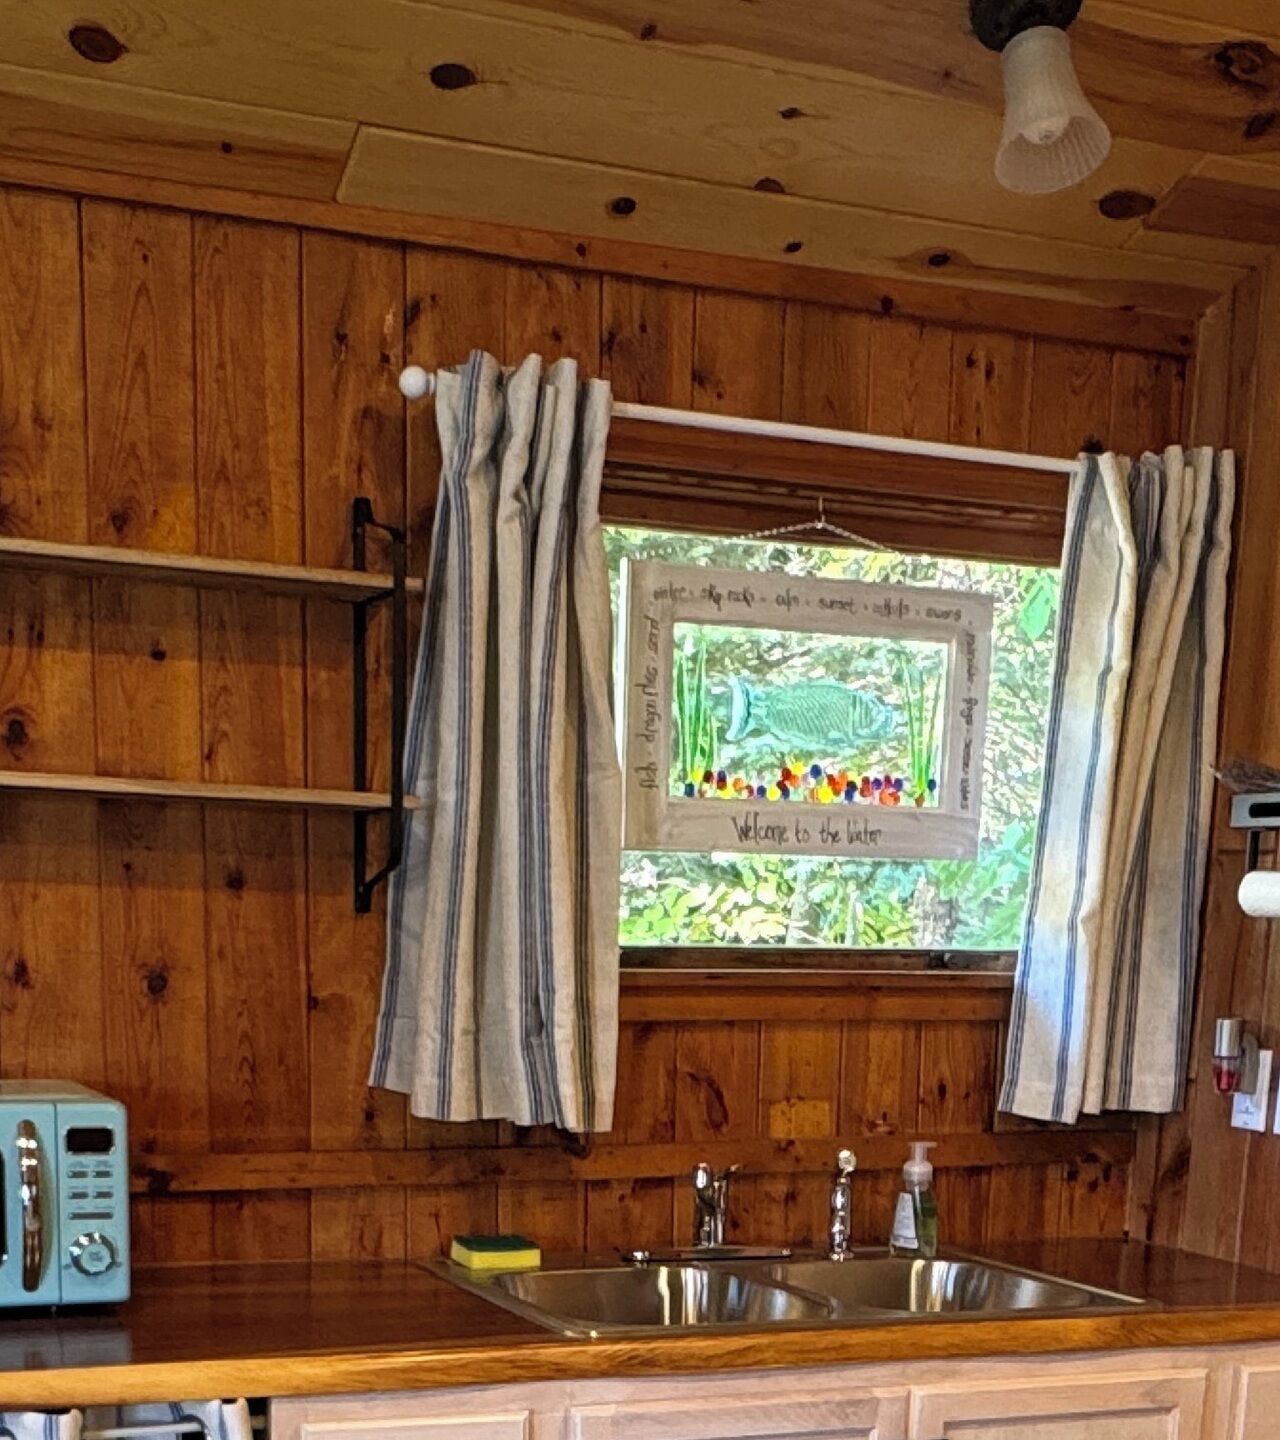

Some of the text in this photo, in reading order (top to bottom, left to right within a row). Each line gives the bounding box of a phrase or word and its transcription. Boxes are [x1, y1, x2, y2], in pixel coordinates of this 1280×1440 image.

[731, 811, 789, 846] Welcome
[794, 817, 810, 844] to
[819, 815, 841, 846] the
